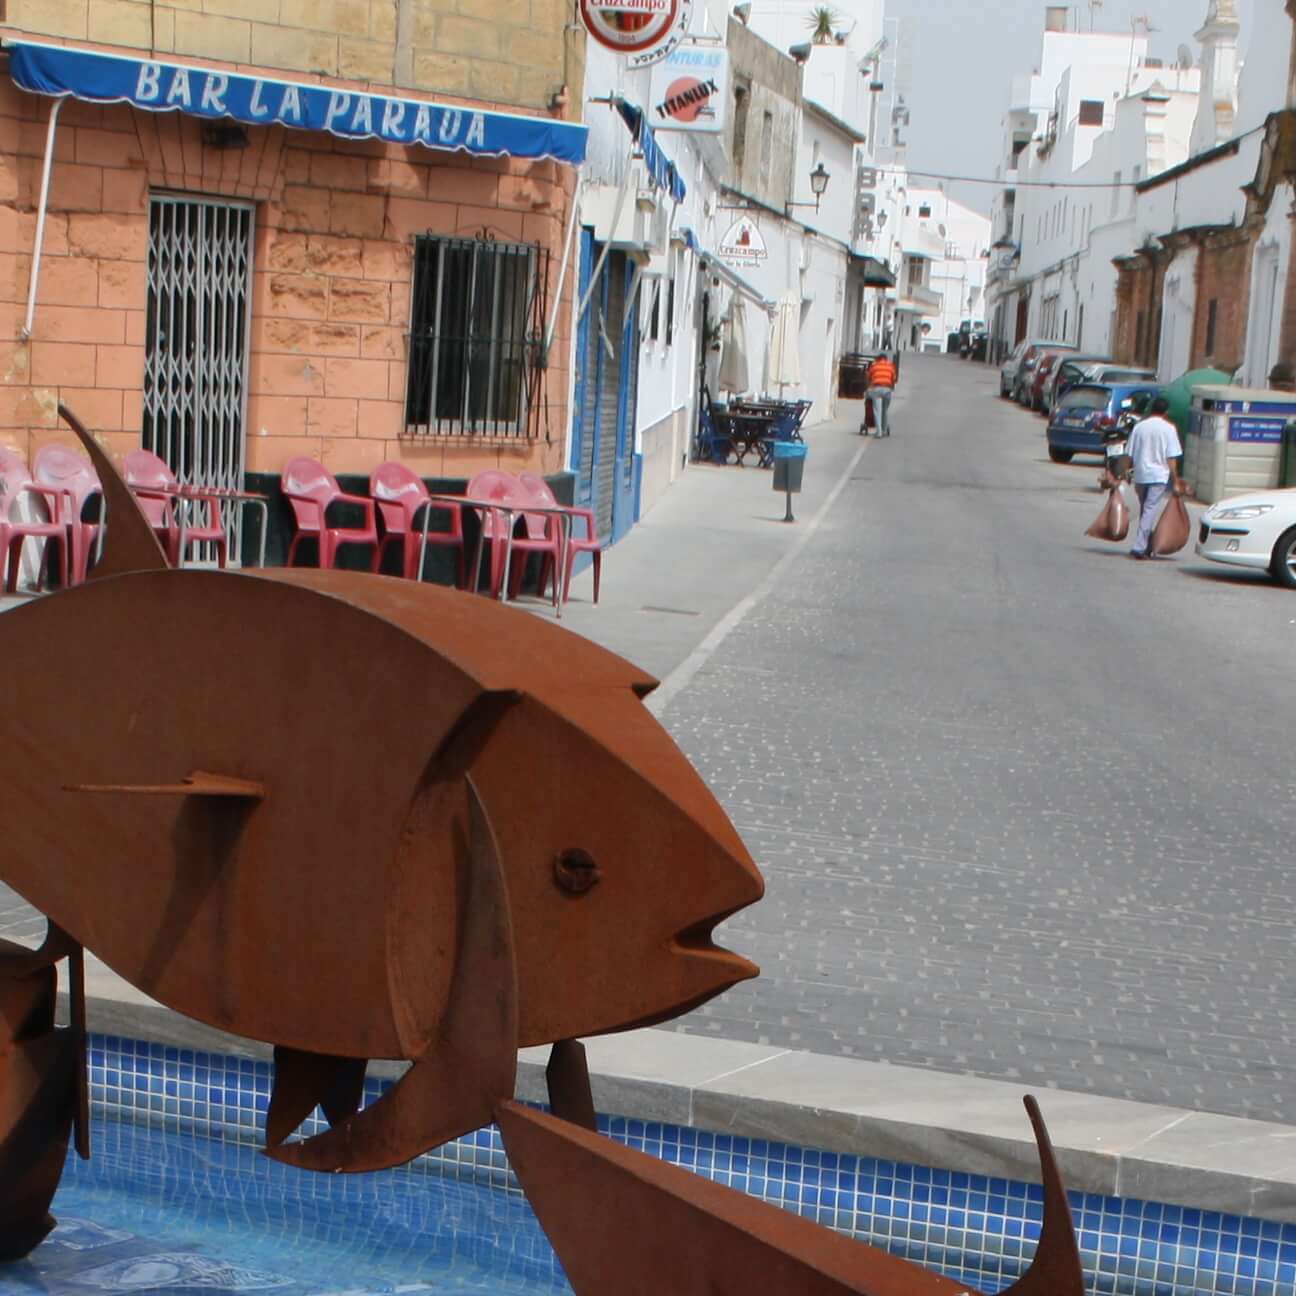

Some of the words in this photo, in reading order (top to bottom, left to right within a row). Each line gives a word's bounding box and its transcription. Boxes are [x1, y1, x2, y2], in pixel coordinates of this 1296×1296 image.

[135, 62, 230, 113] BAR
[250, 79, 302, 122] LA
[656, 77, 719, 119] TITANLUX
